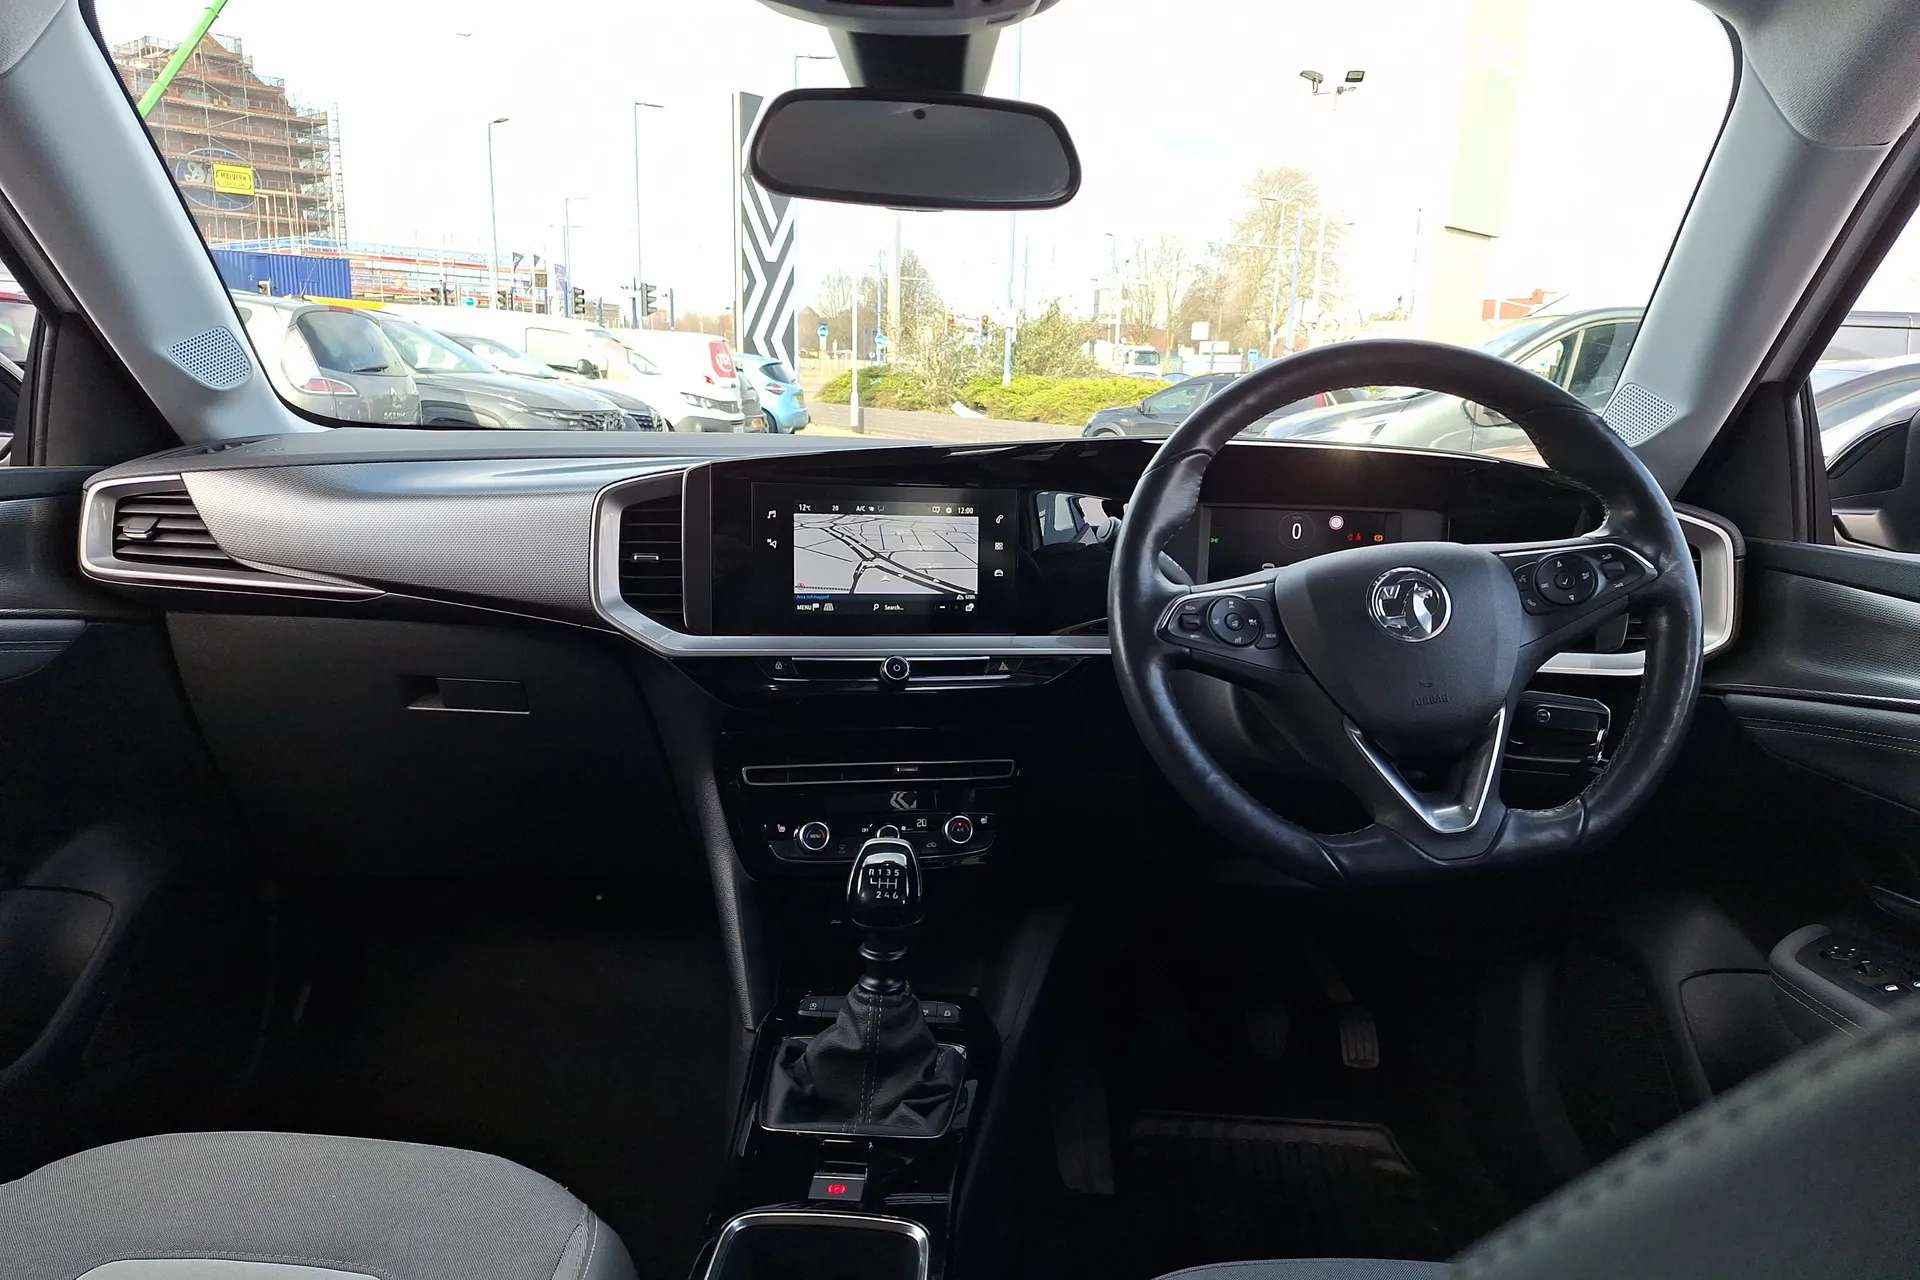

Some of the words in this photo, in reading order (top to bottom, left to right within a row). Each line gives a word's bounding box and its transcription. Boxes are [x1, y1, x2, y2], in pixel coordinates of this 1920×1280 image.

[855, 504, 866, 512] A/C
[957, 506, 974, 515] 12:00
[1291, 522, 1302, 540] 0
[916, 818, 927, 828] 20
[868, 868, 875, 876] R
[885, 868, 891, 876] 3
[894, 869, 900, 877] 5
[875, 890, 882, 899] 2
[884, 891, 890, 899] 4
[892, 891, 899, 900] 6
